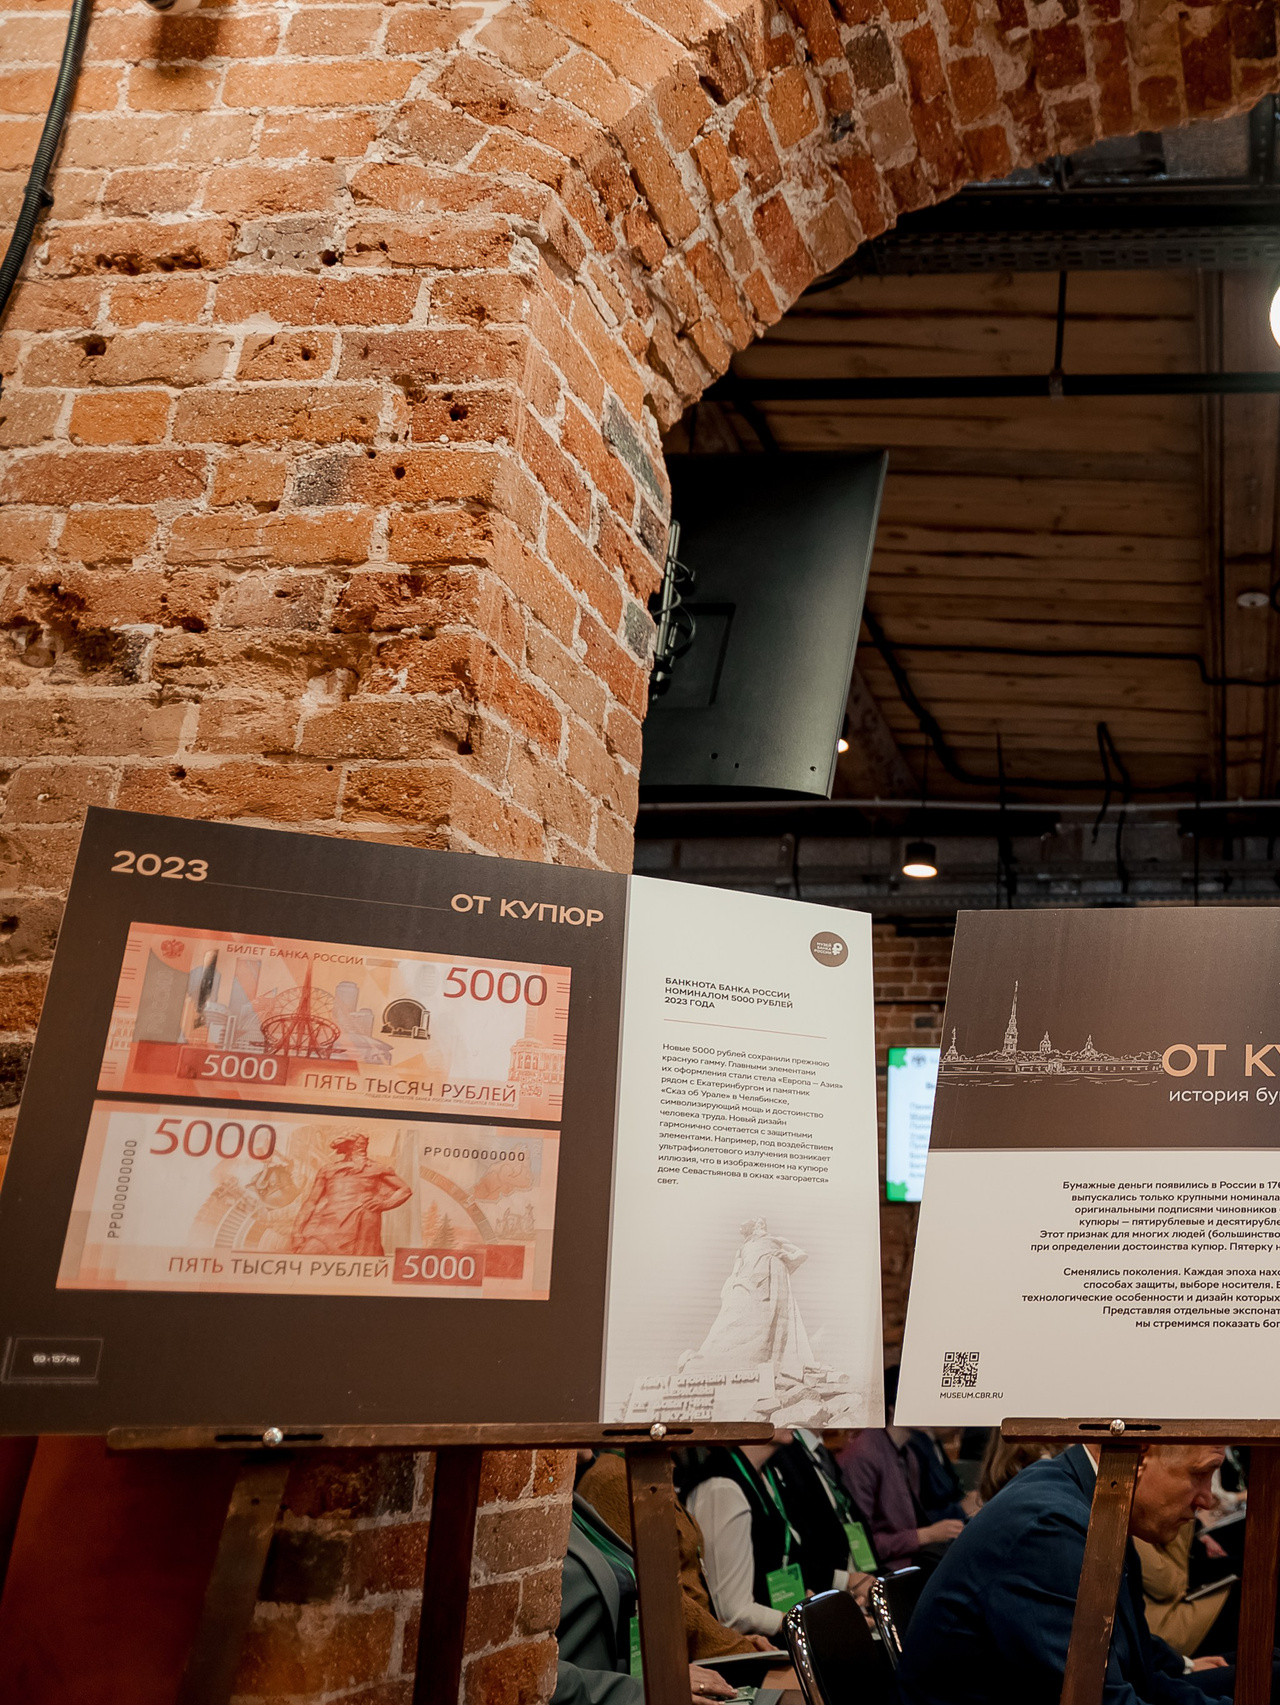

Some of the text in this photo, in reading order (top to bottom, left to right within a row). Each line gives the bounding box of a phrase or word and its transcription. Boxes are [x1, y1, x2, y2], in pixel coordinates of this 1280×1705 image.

[111, 850, 209, 881] 2023
[450, 893, 604, 927] ОТ КУПЮР
[226, 943, 363, 966] БИЛЕТ БАНКА РОССИИ
[443, 967, 548, 1007] 5000
[664, 986, 793, 1009] НОМИНАЛОМ 5000 РУБЛЕЙ
[665, 976, 790, 1000] БАНКНОТА БАНКА РОССИИ
[664, 995, 716, 1009] 2023 ГОДА
[661, 1055, 816, 1076] красную гамму. Главными элементами
[662, 1042, 830, 1068] Новые 5000 рублей сохранили прежнюю
[1162, 1043, 1227, 1077] ОТ
[201, 1055, 278, 1081] 5000
[304, 1073, 357, 1092] ПЯТЬ
[365, 1077, 433, 1097] ТЫСЯЧ
[441, 1081, 517, 1103] РУБЛЕЙ
[660, 1086, 687, 1096] «Сказ
[687, 1088, 699, 1097] об
[700, 1089, 731, 1099] Урале»
[1169, 1089, 1249, 1105] история
[659, 1109, 787, 1126] человека труда. Новый дизайн
[149, 1118, 277, 1160] 5000
[656, 1177, 679, 1185] свет.
[1062, 1180, 1116, 1192] Бумажные
[1117, 1182, 1153, 1190] деньги
[1219, 1180, 1257, 1189] России
[1071, 1194, 1138, 1204] выпускались
[1138, 1194, 1175, 1202] только
[1176, 1194, 1228, 1203] крупными
[168, 1257, 389, 1279] ПЯТЬ ТЫСЯЧ РУБЛЕЙ
[402, 1254, 476, 1281] 5000
[1021, 1294, 1113, 1302] технологические
[1114, 1292, 1184, 1302] особенности
[1186, 1294, 1194, 1302] и
[1194, 1292, 1234, 1303] дизайн
[1235, 1294, 1280, 1304] которых
